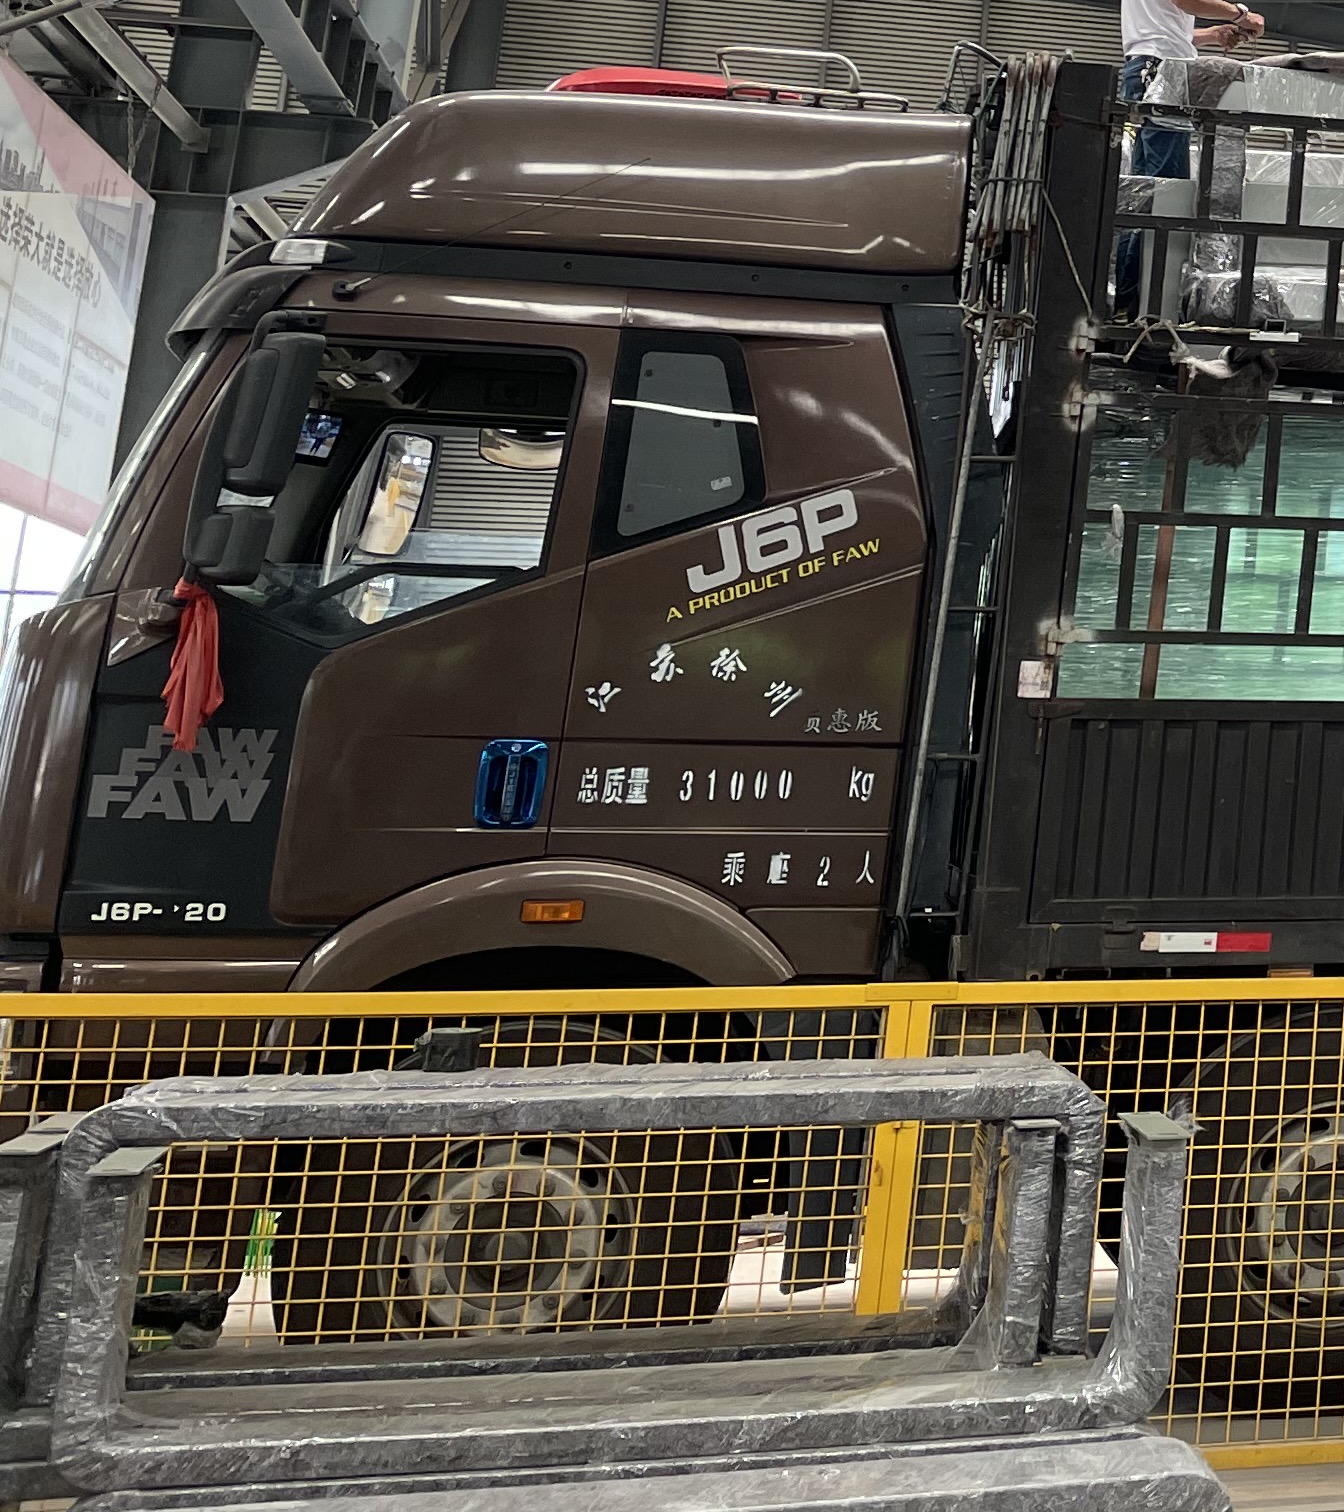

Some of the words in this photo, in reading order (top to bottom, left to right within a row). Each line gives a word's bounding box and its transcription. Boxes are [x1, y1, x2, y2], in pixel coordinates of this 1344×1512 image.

[686, 489, 858, 593] J6P
[666, 607, 682, 622] A
[689, 568, 791, 615] PRODUCT
[798, 554, 826, 578] OF
[833, 538, 880, 567] FAW
[87, 775, 271, 822] FAW
[577, 767, 650, 805] 总质量
[679, 768, 793, 801] 31000
